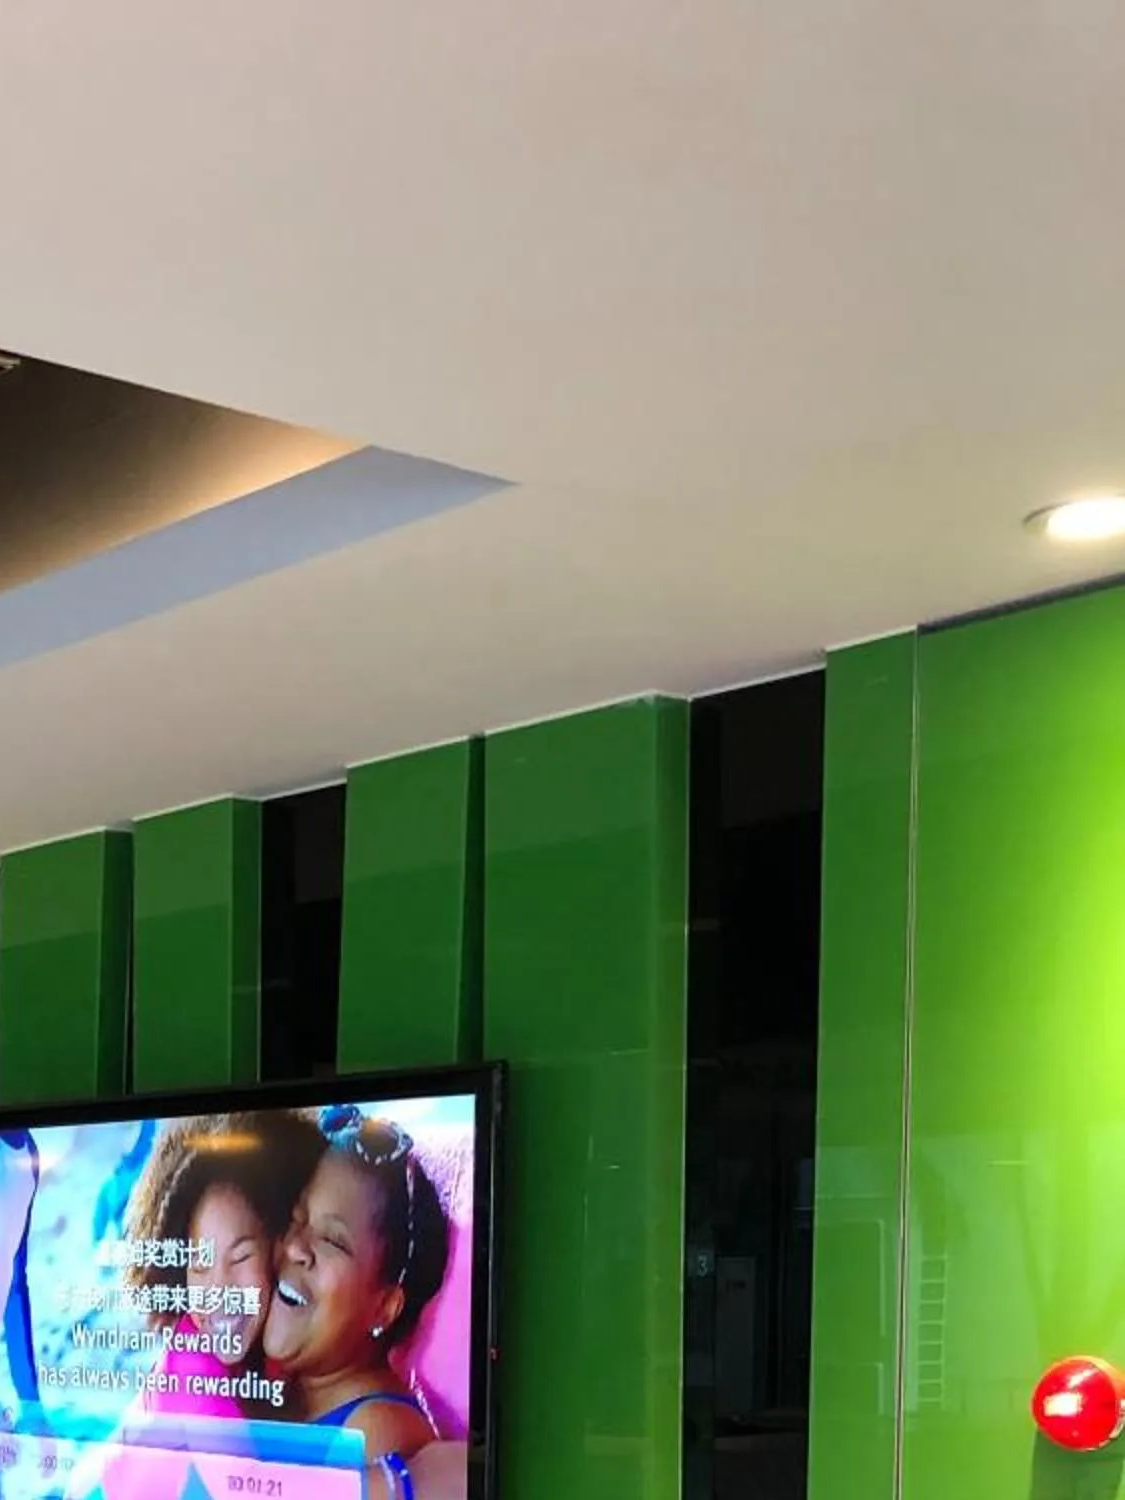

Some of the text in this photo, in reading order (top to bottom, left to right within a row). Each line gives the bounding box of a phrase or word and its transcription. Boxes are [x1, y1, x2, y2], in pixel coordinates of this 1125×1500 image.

[72, 1322, 243, 1355] Wyndham Rewards
[39, 1361, 285, 1407] has always been rewarding
